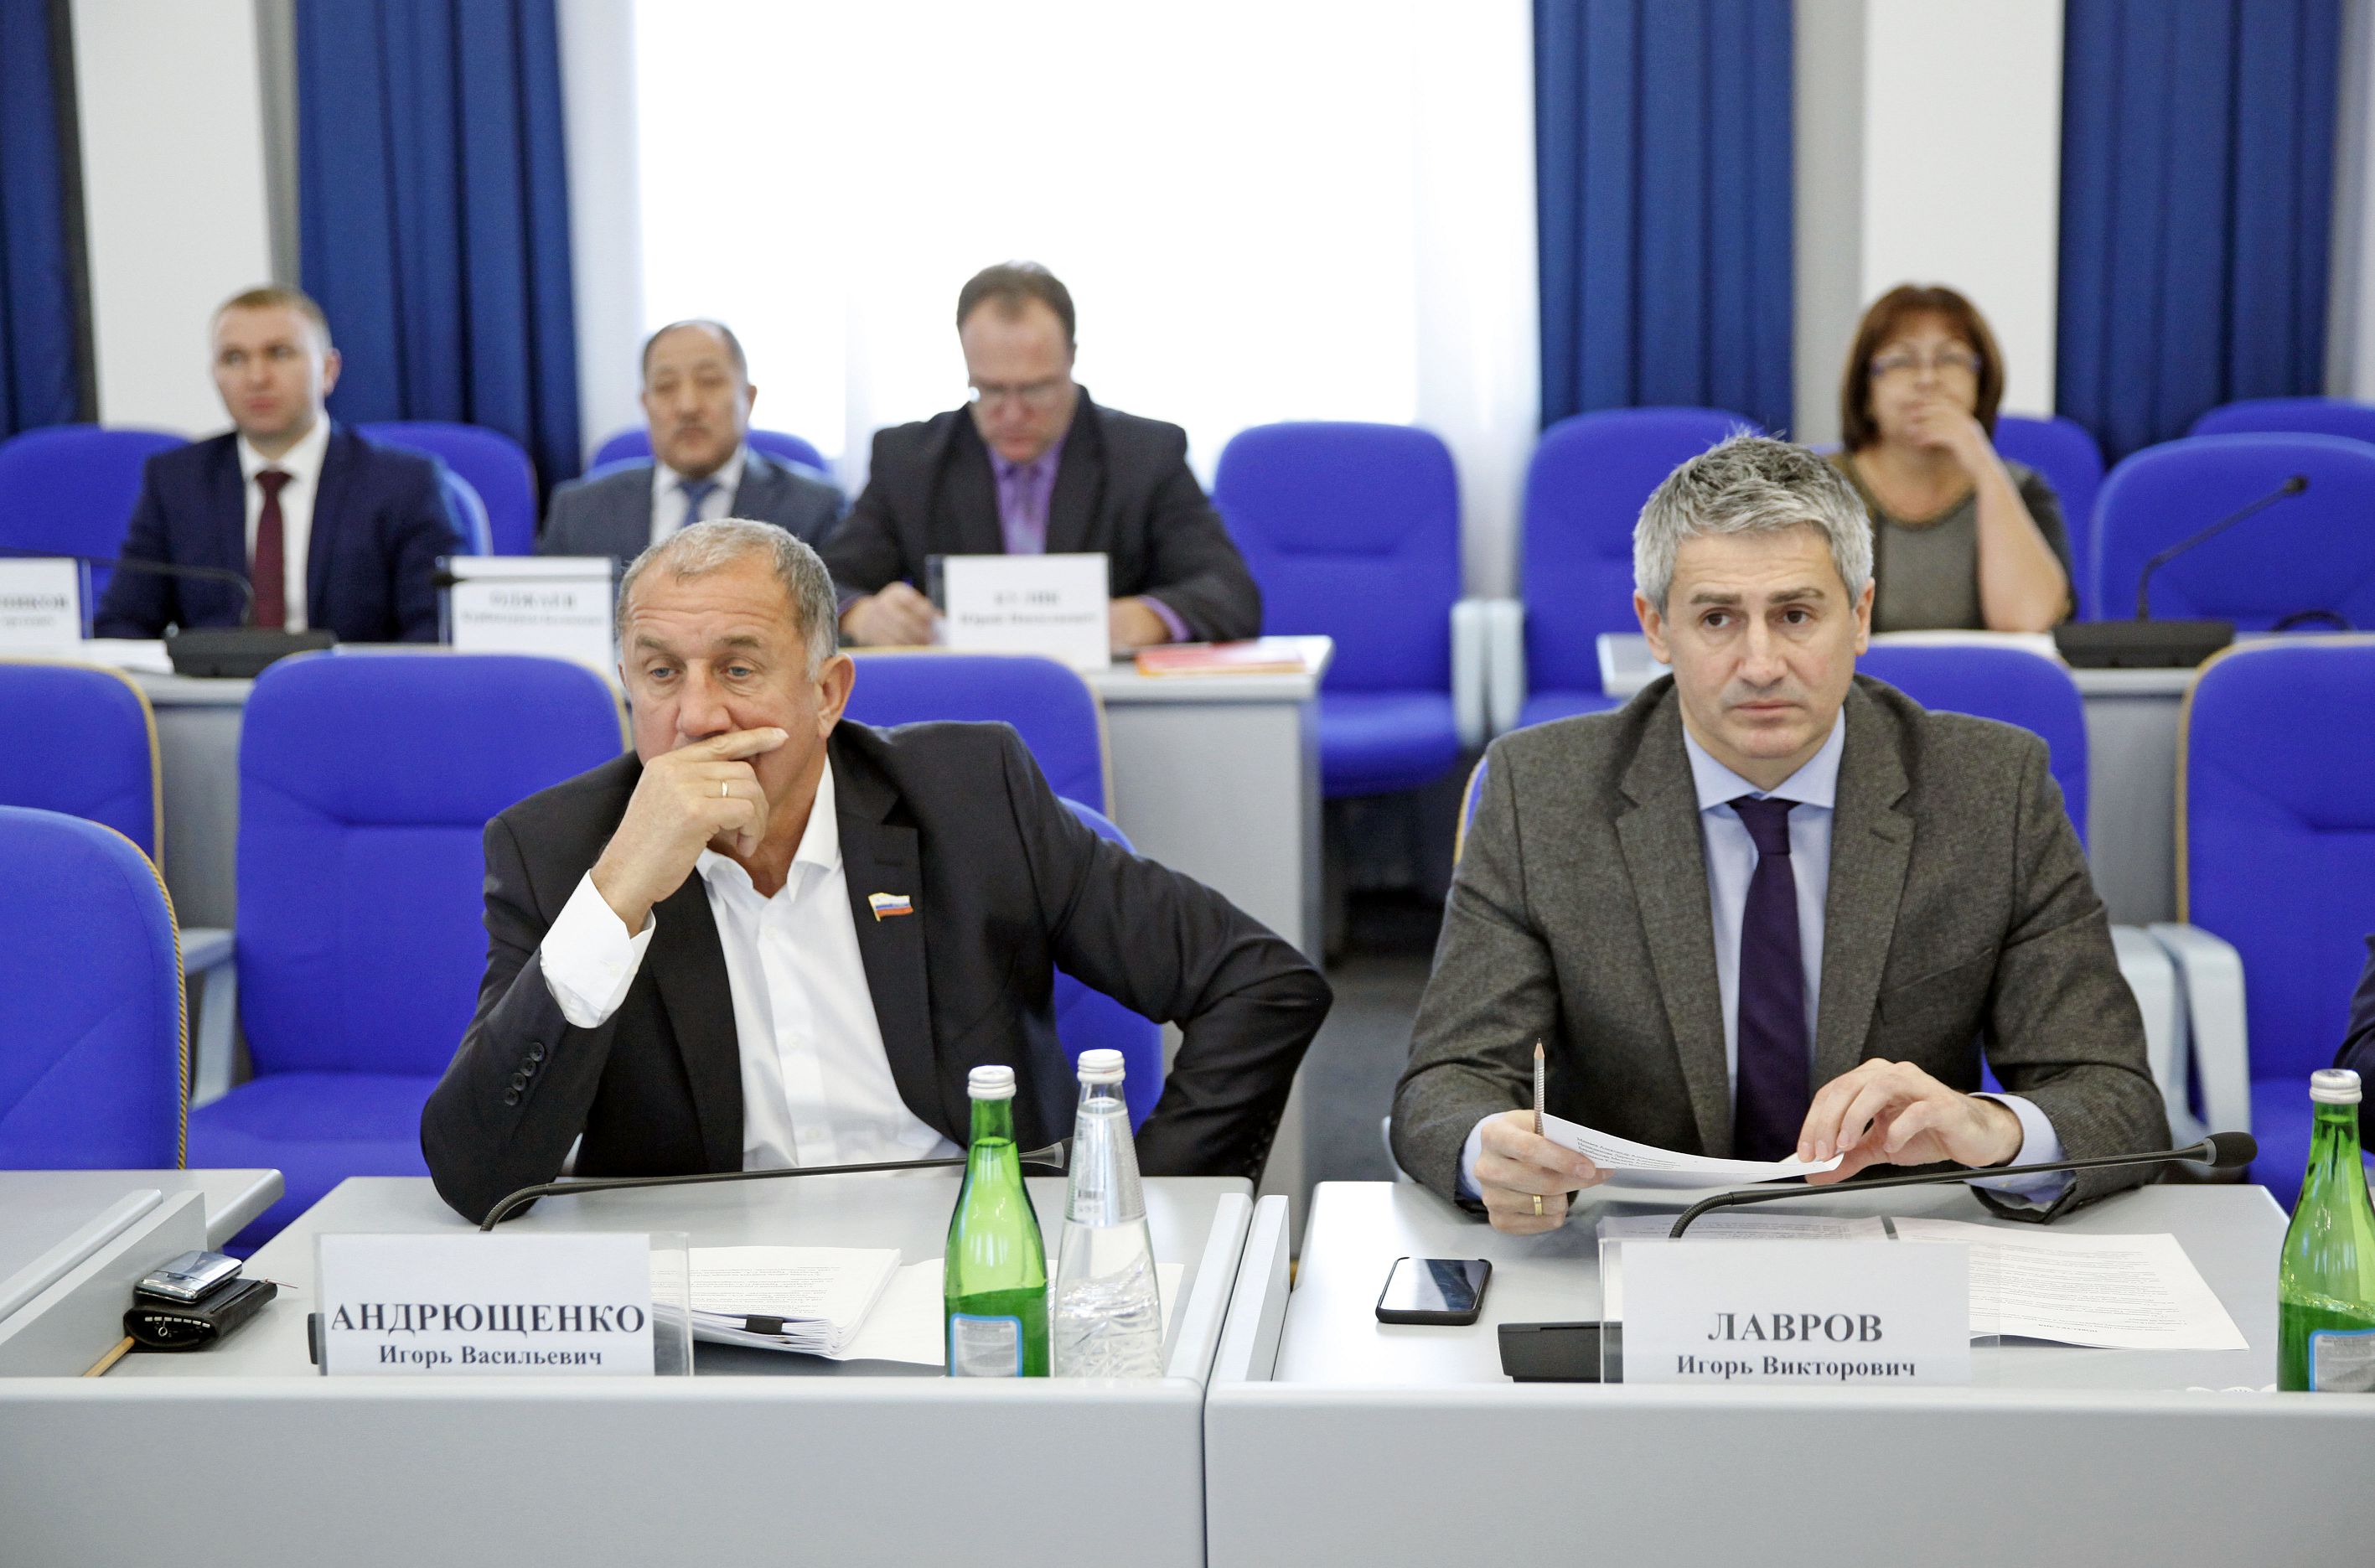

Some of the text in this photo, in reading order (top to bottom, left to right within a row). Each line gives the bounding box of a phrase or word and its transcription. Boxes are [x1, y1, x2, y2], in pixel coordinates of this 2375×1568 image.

[332, 1302, 645, 1337] АНДРЮЩЕНКО
[1707, 1312, 1883, 1342] ЛАВРОВ
[380, 1345, 602, 1369] Игорь Васильевич
[1677, 1355, 1916, 1381] Игорь Викторович
